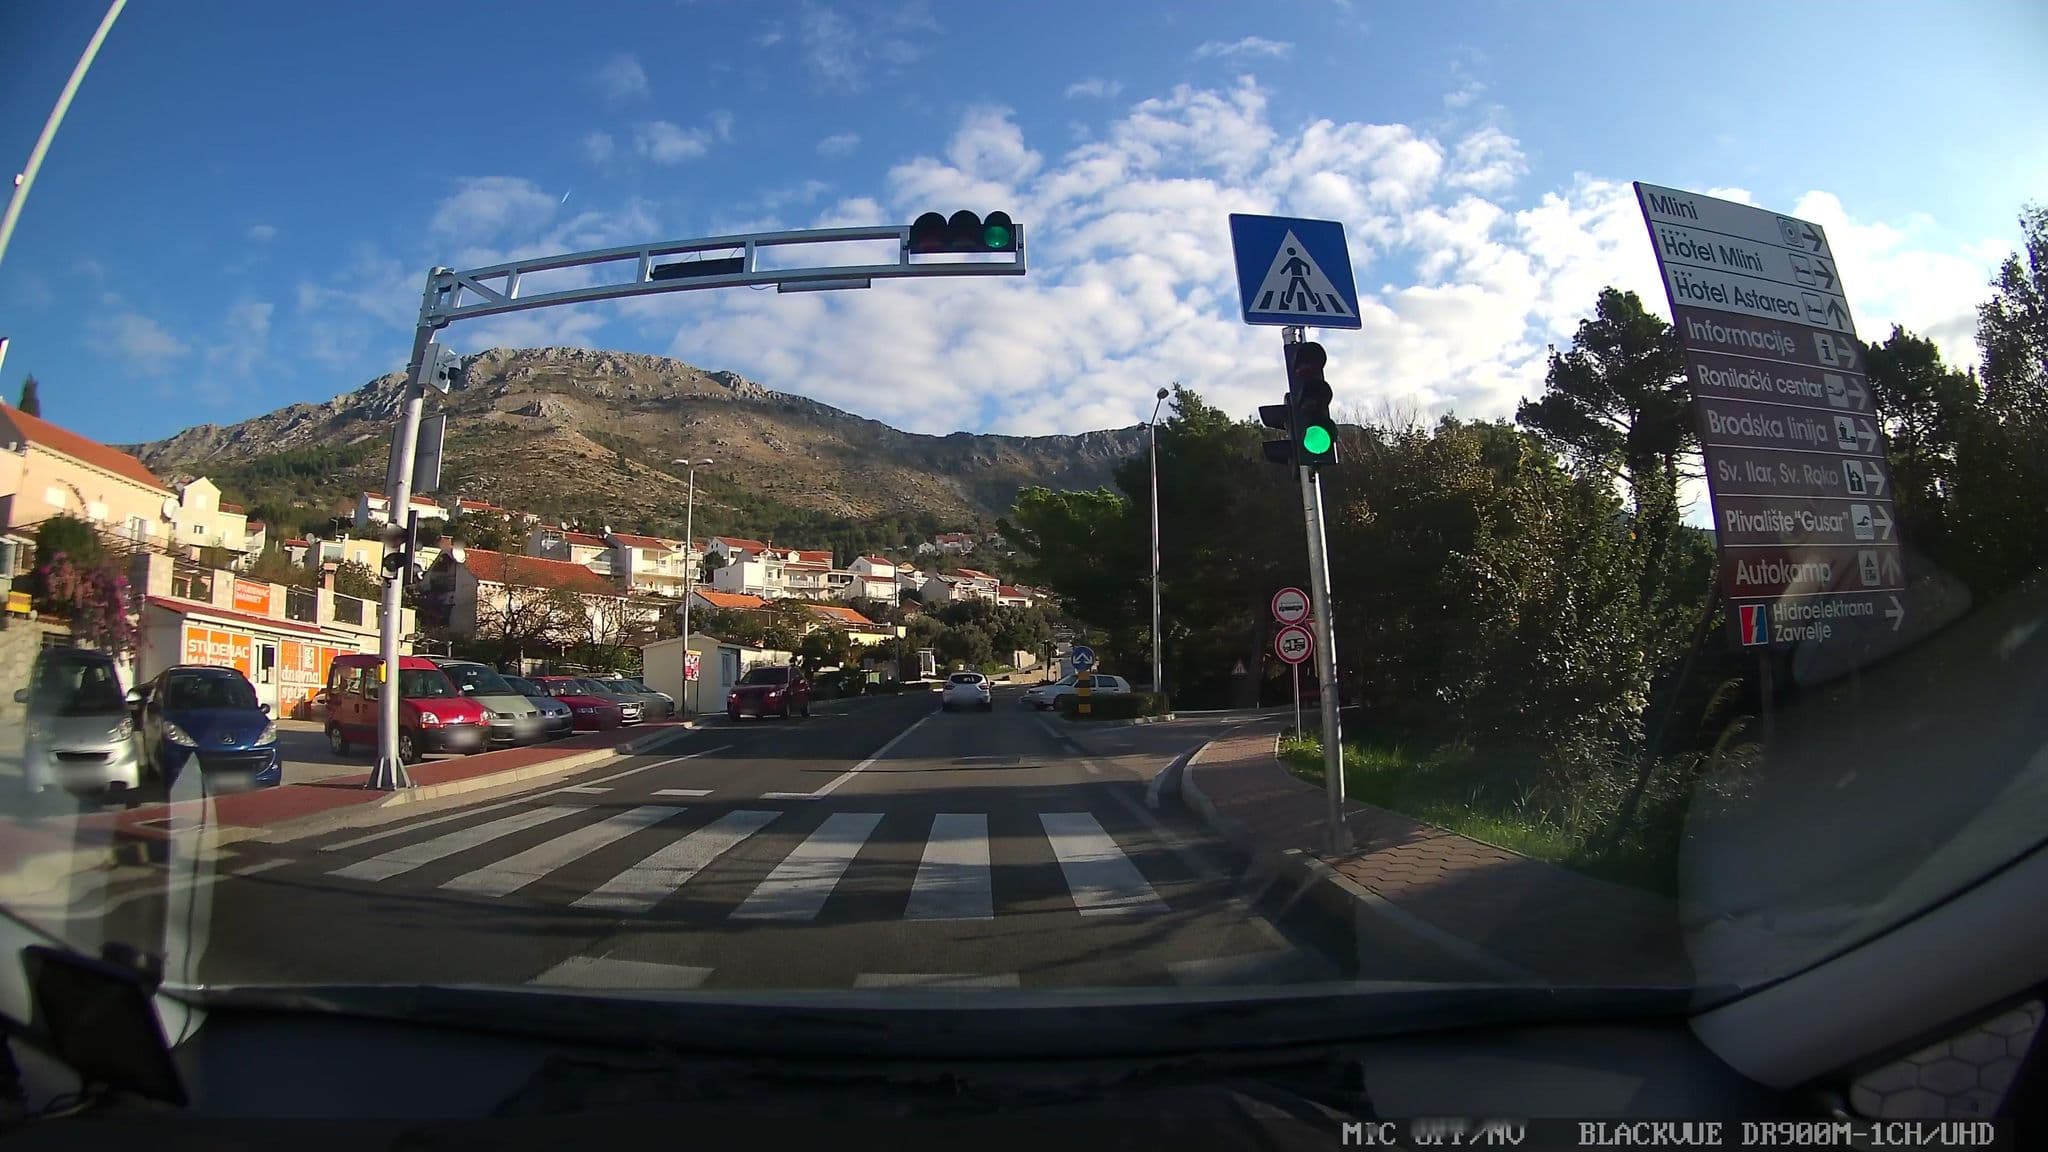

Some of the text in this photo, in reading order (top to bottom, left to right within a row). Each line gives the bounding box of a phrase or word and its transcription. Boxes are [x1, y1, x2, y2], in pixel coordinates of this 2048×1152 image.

[1649, 192, 1699, 220] Mlini
[1662, 232, 1763, 272] Hotel Mlini
[1674, 275, 1800, 317] Hotel Astarea
[1686, 316, 1795, 356] Informacije
[1697, 364, 1822, 397] Ronilački centar
[1707, 409, 1828, 445] Brodska linija
[1718, 459, 1741, 483] Sv.
[1747, 462, 1776, 485] Ilar,
[1779, 464, 1799, 484] Sv.
[1726, 509, 1794, 533] Plivalište
[1736, 560, 1831, 585] Autokamp
[1773, 601, 1873, 621] Hidroelektrana
[1775, 623, 1831, 642] Zavrelje
